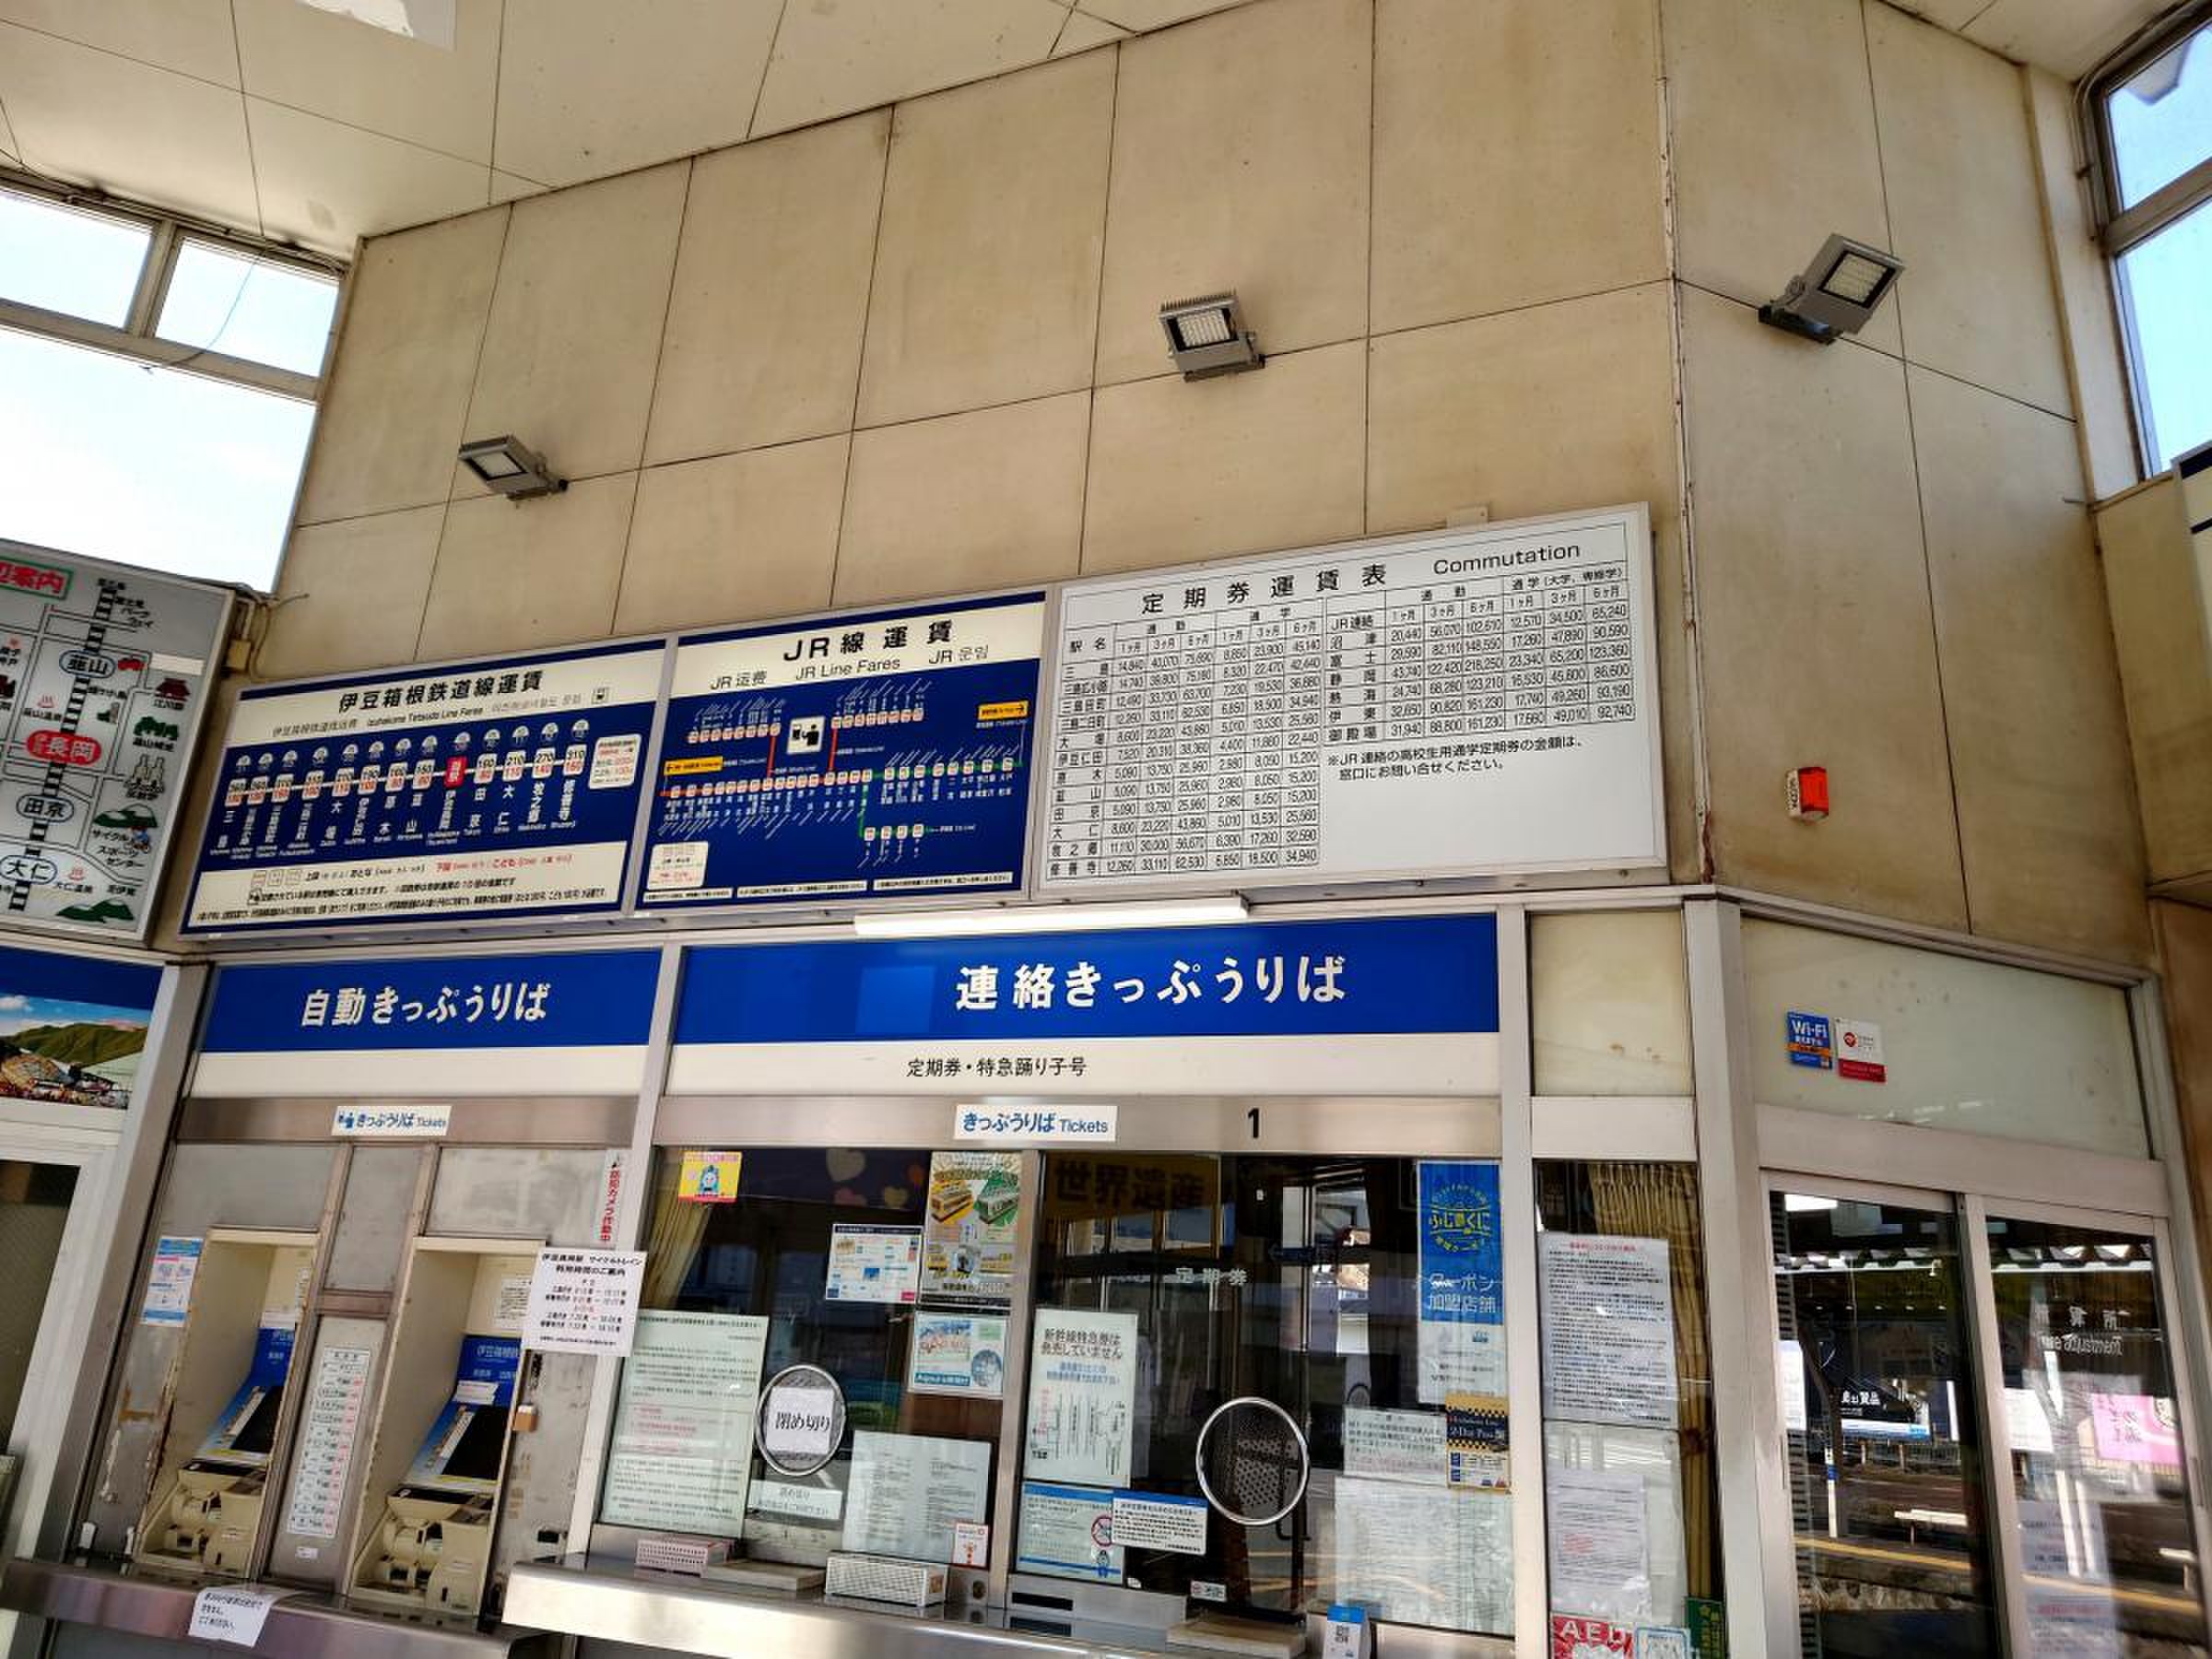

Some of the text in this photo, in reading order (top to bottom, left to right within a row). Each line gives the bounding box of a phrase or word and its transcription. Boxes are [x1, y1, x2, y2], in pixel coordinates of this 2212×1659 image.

[1141, 545, 1581, 615] 定期券運賃表 Commutation
[784, 619, 952, 661] JR線運賃
[795, 656, 900, 680] JR Line Fares
[929, 649, 952, 665] JR
[338, 669, 544, 713] 伊豆箱根鉄道線運賃
[711, 675, 733, 690] JR
[24, 798, 65, 818] 田京
[6, 859, 50, 880] 大仁
[956, 955, 1347, 1011] 連絡きっぷうりば
[300, 982, 550, 1028] 自動きっぷうりば
[1792, 1018, 1829, 1039] Wi-Fi
[906, 1055, 1088, 1079] 定期券・特急踊り子号
[355, 1110, 447, 1130] きっぷうりば Tickets
[961, 1111, 1109, 1135] きっぷうりば Tickets
[1248, 1107, 1261, 1139] 1
